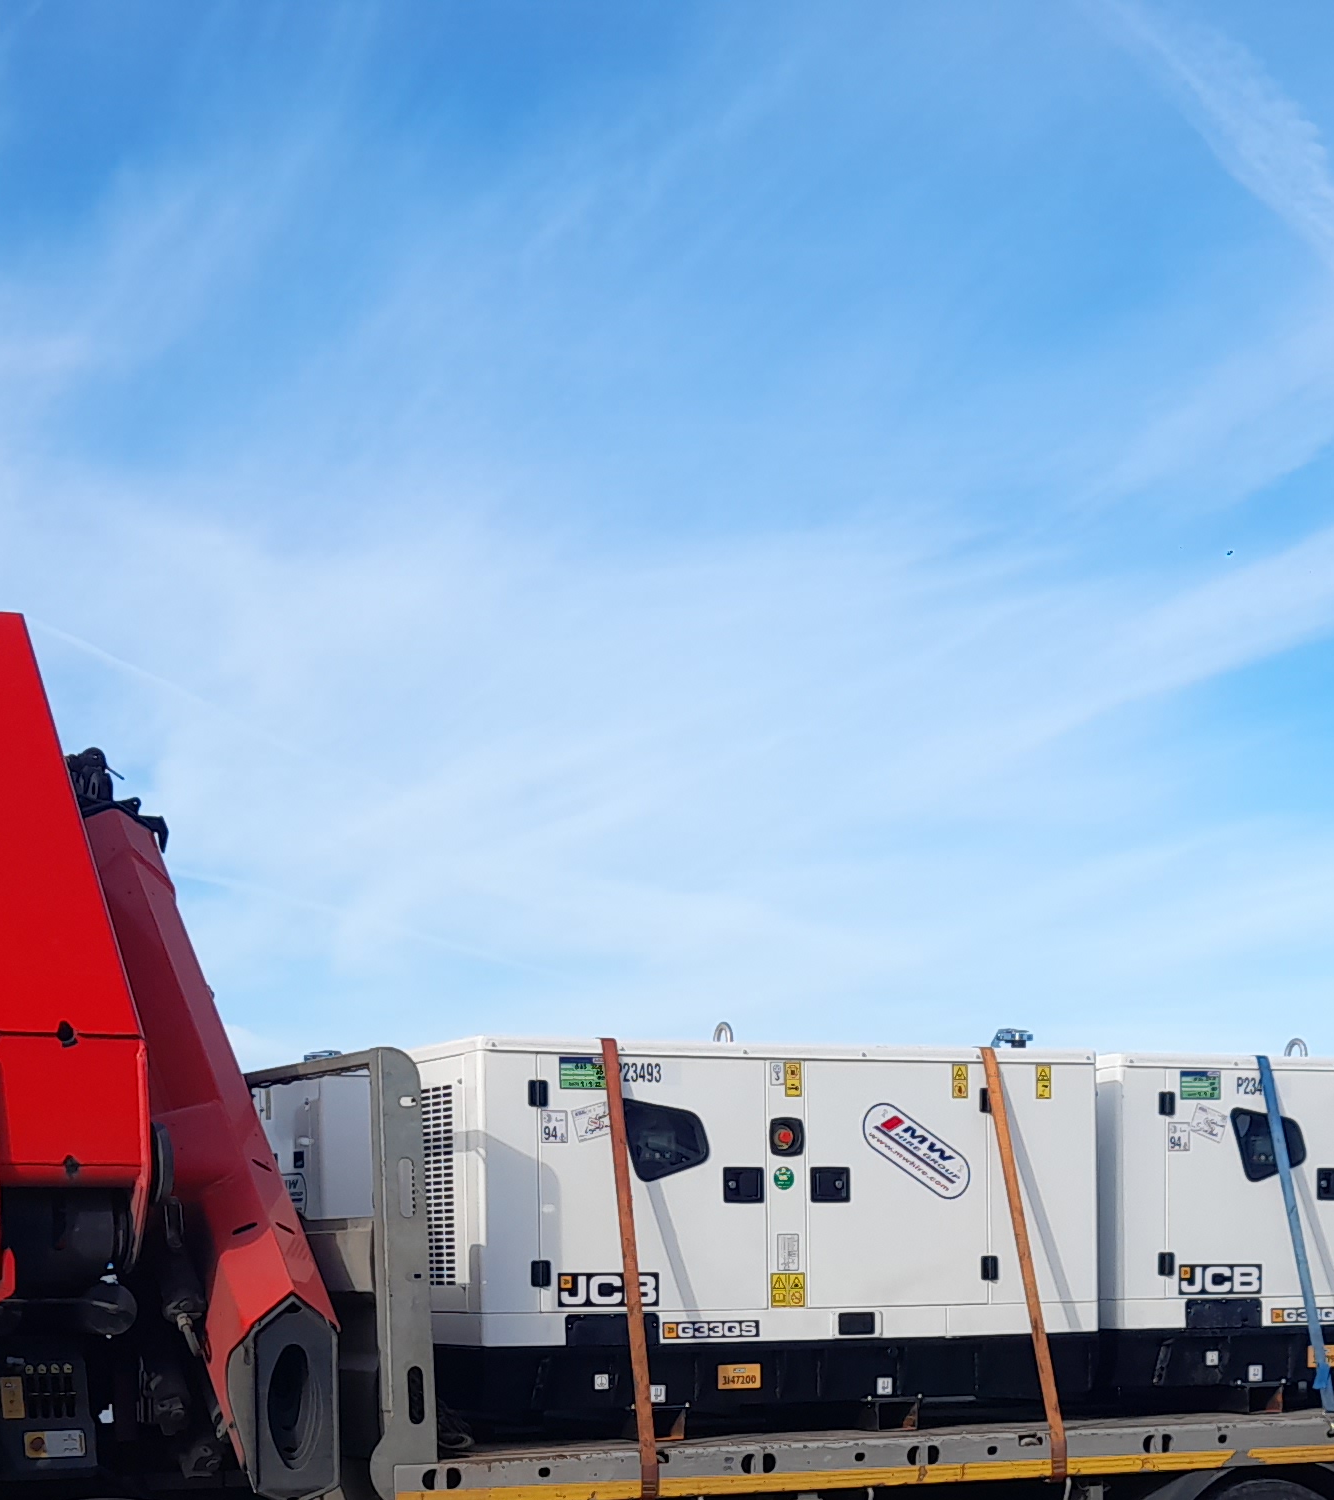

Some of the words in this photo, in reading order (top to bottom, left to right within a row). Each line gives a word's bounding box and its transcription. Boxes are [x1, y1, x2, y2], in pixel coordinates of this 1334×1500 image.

[618, 1062, 662, 1083] 23493
[1235, 1076, 1264, 1096] P234
[543, 1125, 558, 1141] 94
[900, 1125, 956, 1162] MW
[1169, 1135, 1182, 1150] 94
[869, 1131, 950, 1193] www.mwhire.com
[560, 1274, 658, 1305] JCB
[1180, 1265, 1261, 1294] JCB
[677, 1321, 759, 1338] G33QS
